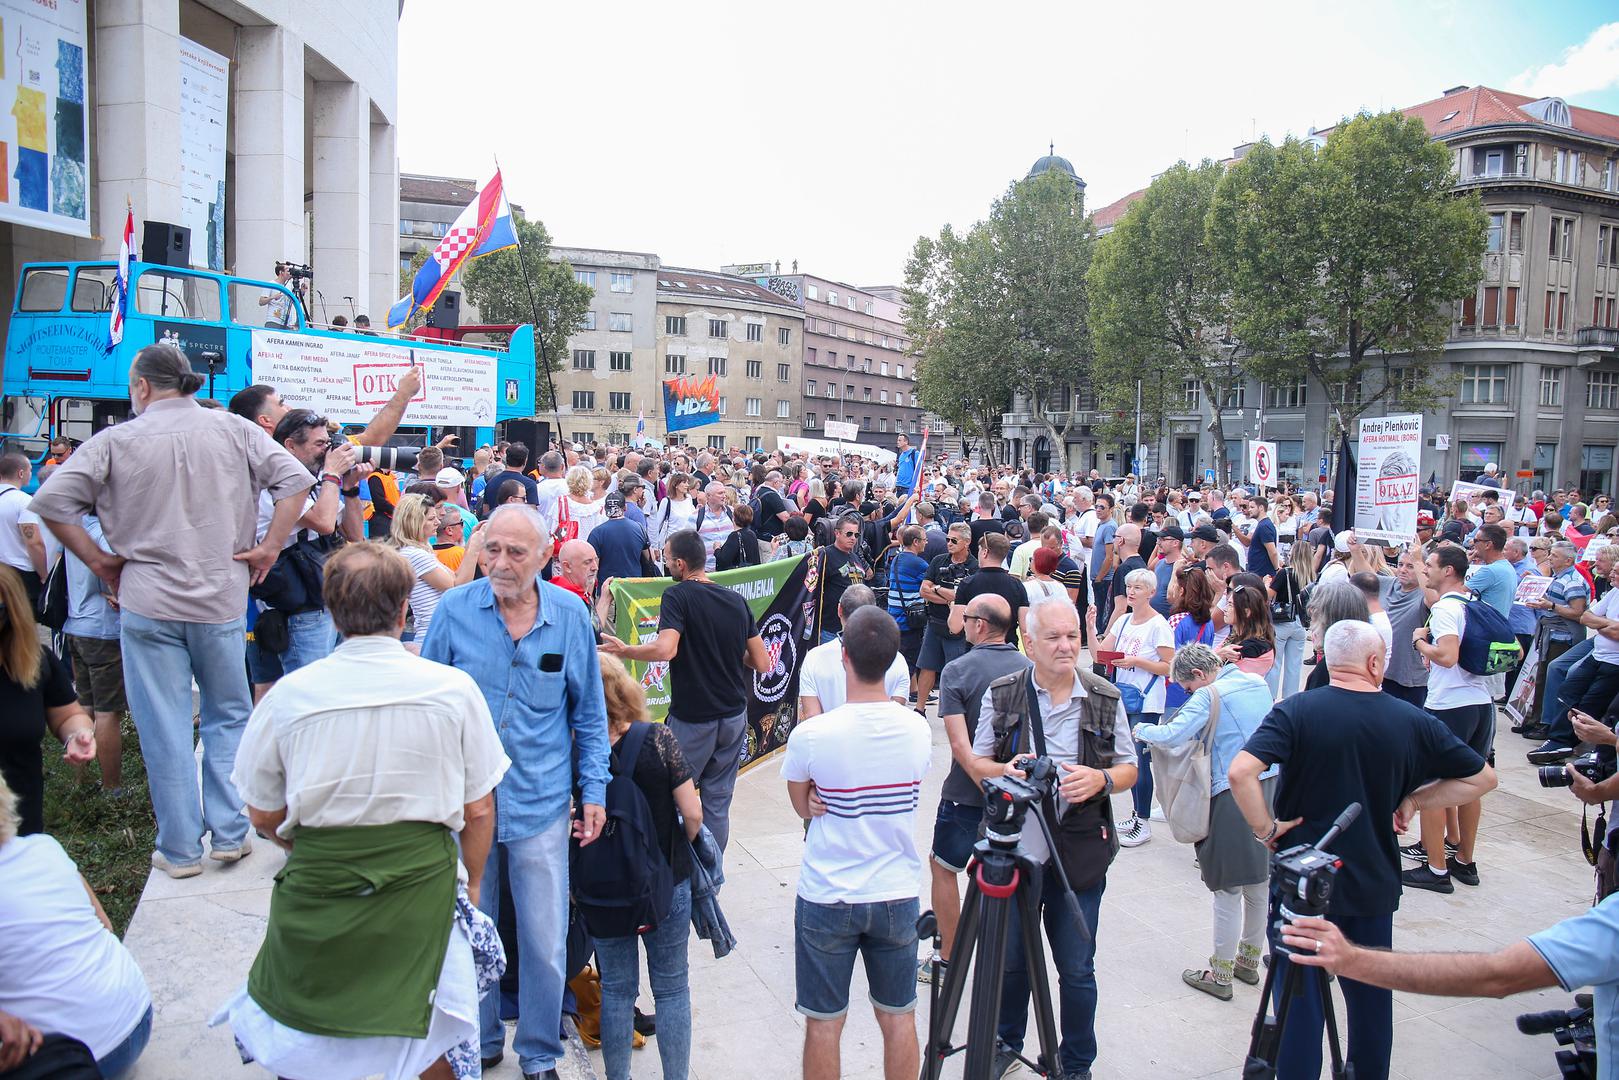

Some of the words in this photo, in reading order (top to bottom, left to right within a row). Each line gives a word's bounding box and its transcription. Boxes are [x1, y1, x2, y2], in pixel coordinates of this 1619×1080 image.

[189, 342, 224, 351] SPECTRE
[266, 337, 284, 345] AFERA
[285, 340, 304, 348] KAMEN
[304, 341, 324, 350] INGRAD
[36, 344, 89, 356] ROUTEMASTER
[257, 351, 275, 359] AFERA
[48, 355, 73, 367] TOUR
[362, 374, 399, 393] OTK
[1361, 421, 1384, 435] Andrej
[1384, 418, 1419, 432] Plenković
[1362, 434, 1378, 443] AFERA
[1378, 434, 1400, 443] HOTMAIL
[1379, 482, 1413, 498] OTKAZ
[725, 577, 775, 601] JEDINJENJA
[768, 622, 782, 634] HOS
